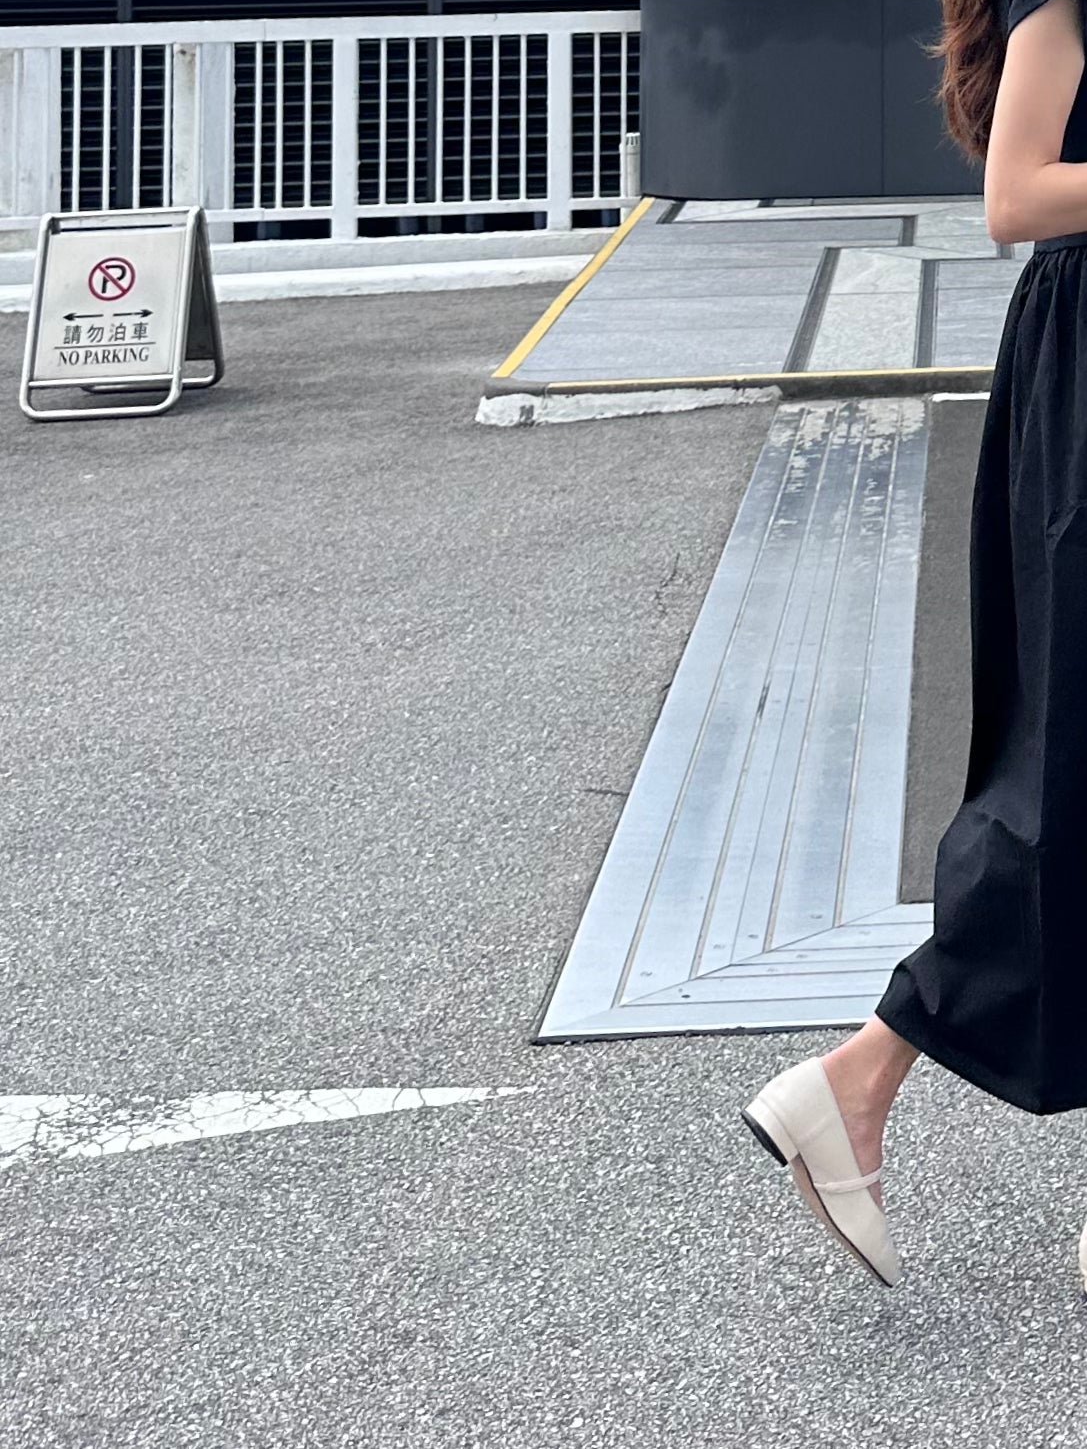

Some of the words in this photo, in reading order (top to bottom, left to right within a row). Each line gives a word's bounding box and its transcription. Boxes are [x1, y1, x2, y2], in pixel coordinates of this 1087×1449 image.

[63, 321, 149, 345] 請勿泊車
[59, 350, 80, 366] NO
[83, 347, 150, 365] PARKING
